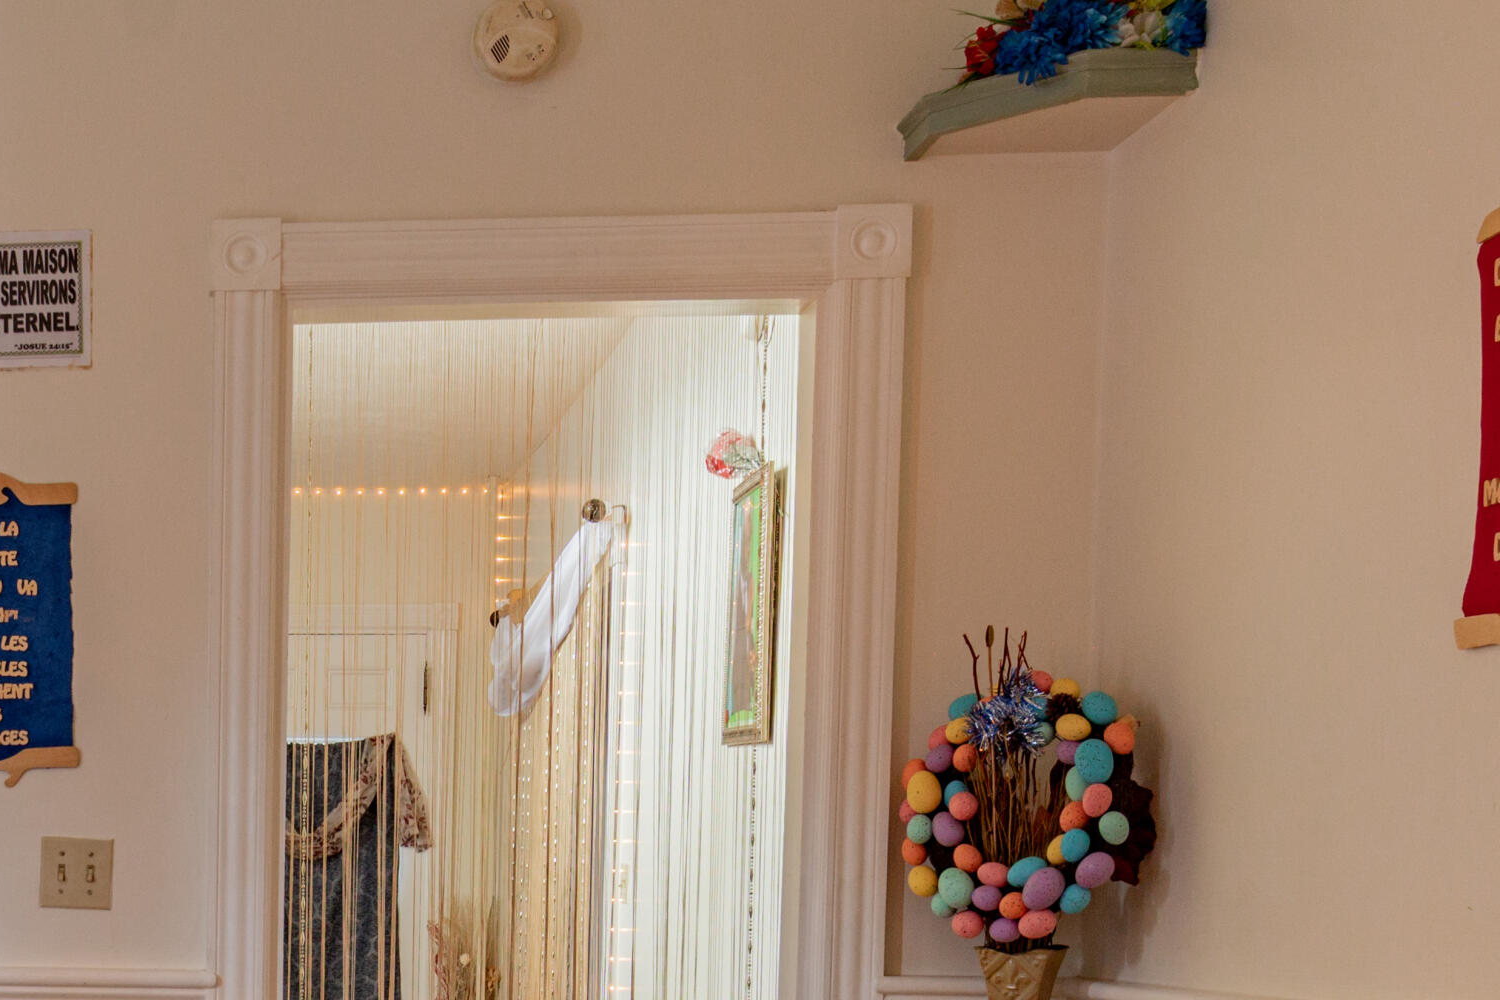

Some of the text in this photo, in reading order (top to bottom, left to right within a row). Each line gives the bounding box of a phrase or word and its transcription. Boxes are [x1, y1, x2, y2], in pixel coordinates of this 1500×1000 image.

[23, 248, 78, 273] MAISON
[1, 279, 76, 306] SERVIRONS
[0, 522, 19, 537] LA
[17, 579, 38, 596] VA
[1, 635, 28, 651] LES
